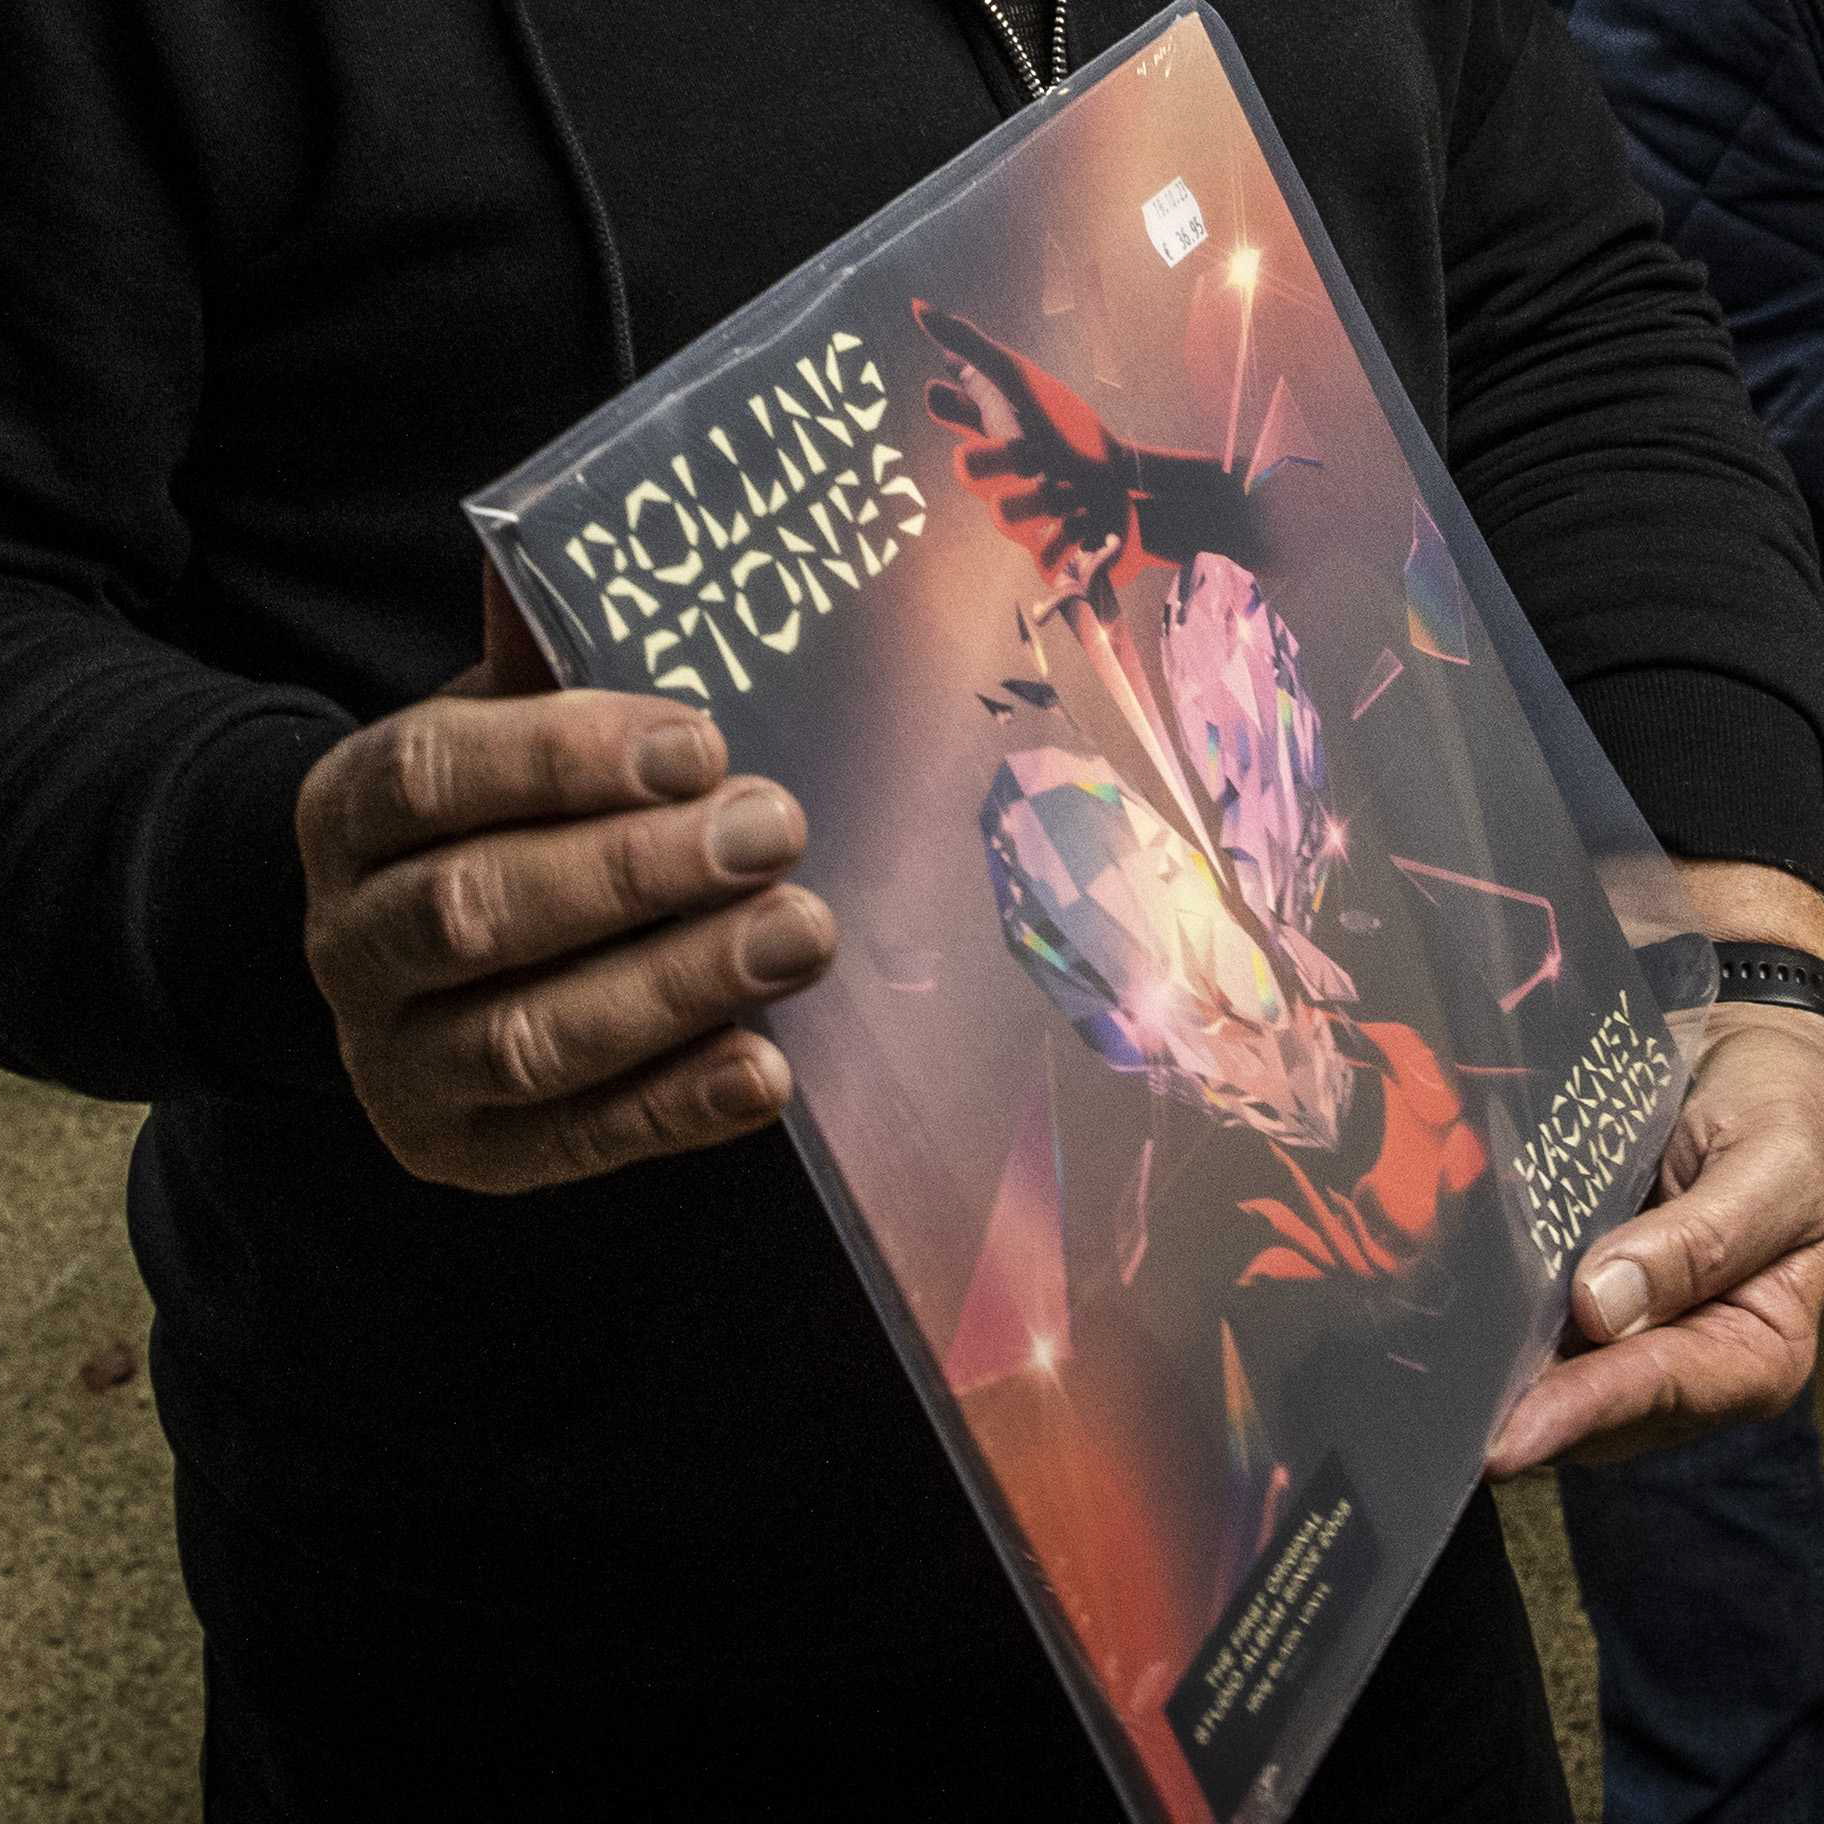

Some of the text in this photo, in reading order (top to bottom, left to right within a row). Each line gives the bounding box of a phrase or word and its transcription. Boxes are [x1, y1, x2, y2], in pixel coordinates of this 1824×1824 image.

[566, 331, 888, 642] ROLLING
[644, 443, 927, 711] STONES
[1513, 989, 1640, 1210] HACKNEY
[1530, 1036, 1672, 1280] DIAMONDS
